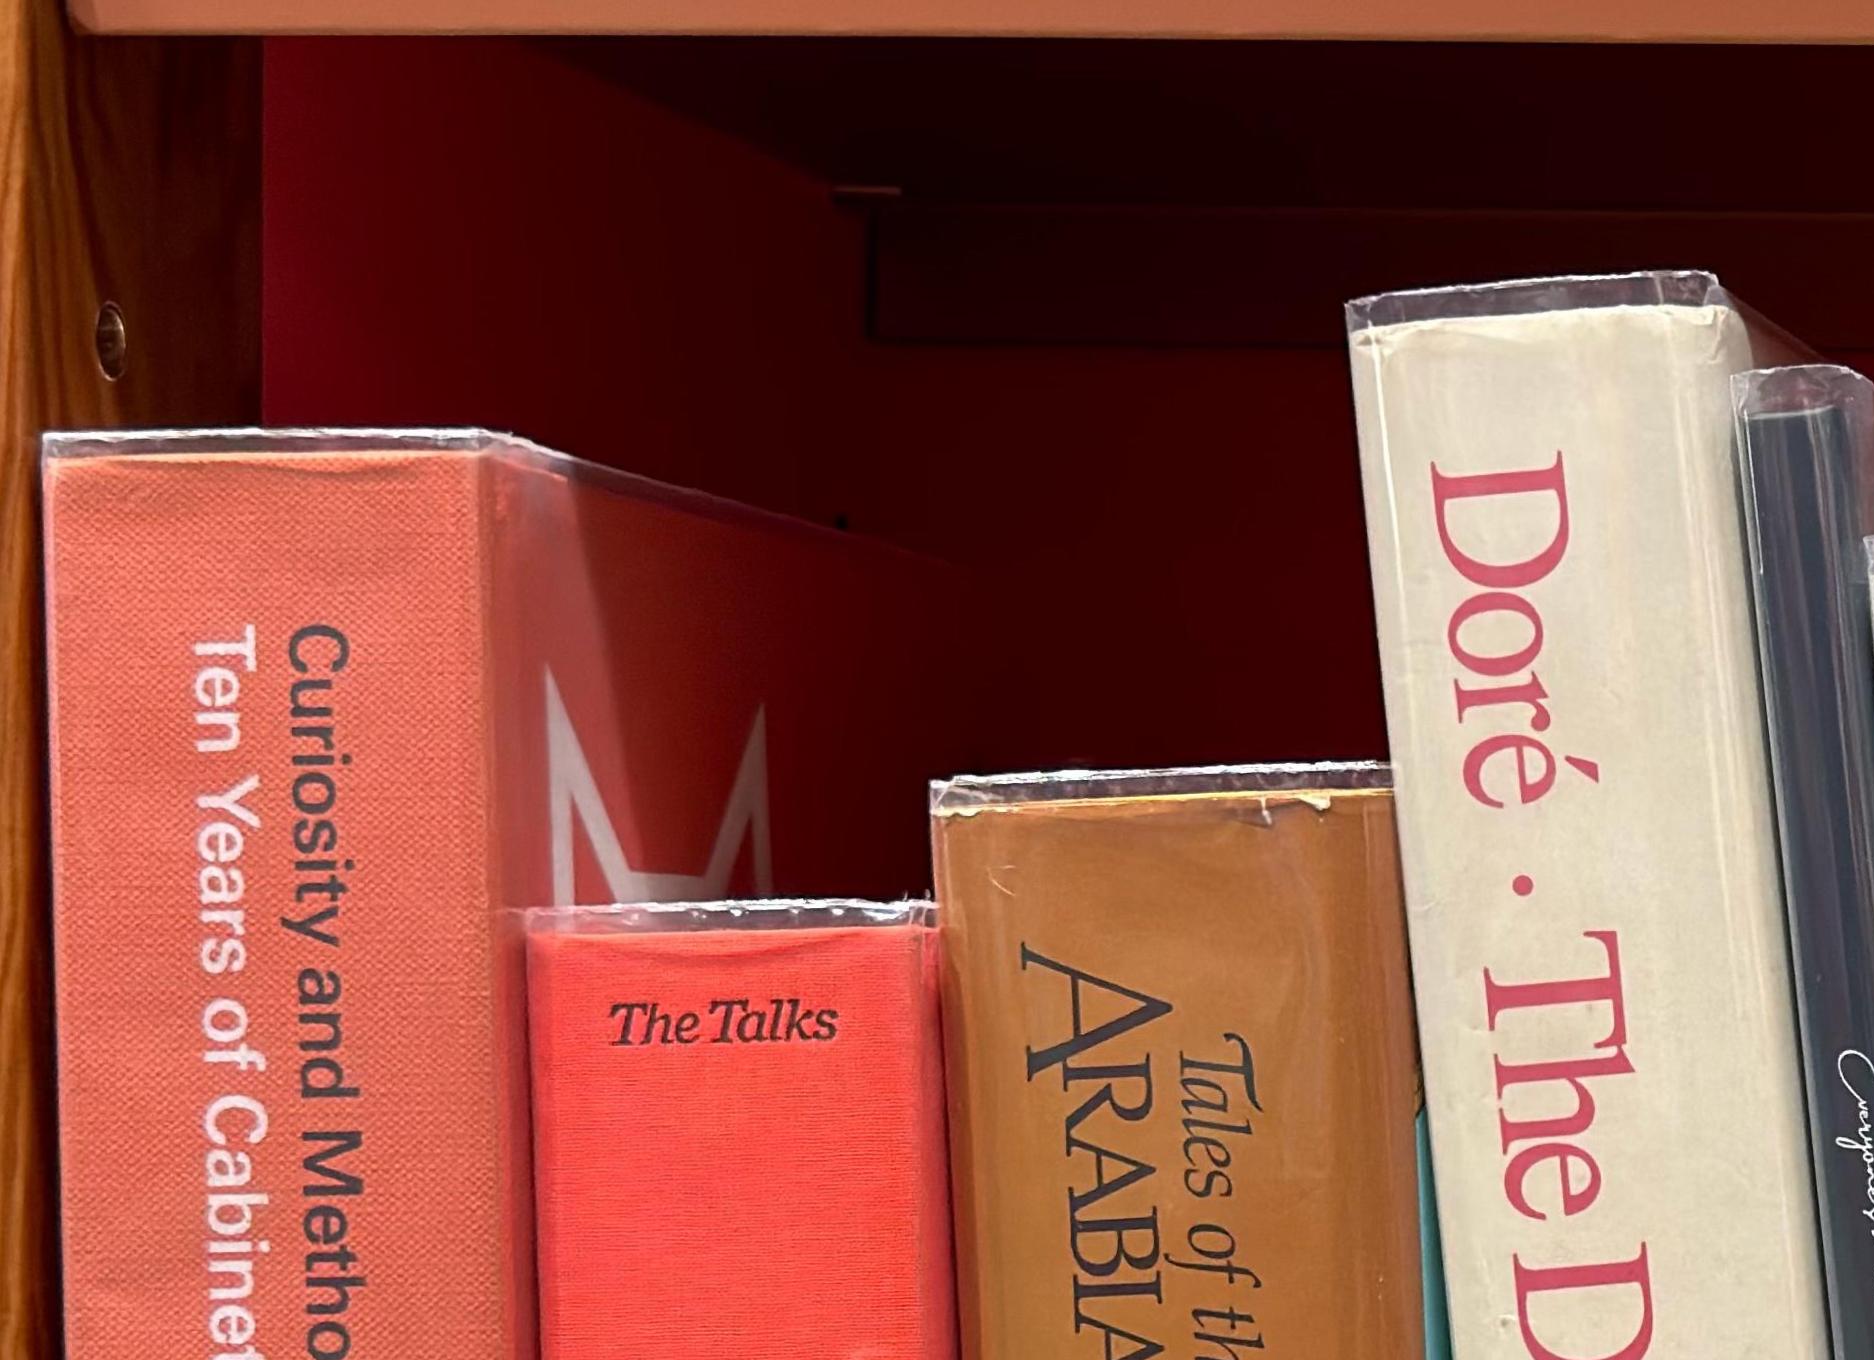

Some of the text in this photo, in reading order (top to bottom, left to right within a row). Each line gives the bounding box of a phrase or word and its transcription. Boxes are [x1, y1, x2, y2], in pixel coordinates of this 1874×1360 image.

[193, 624, 257, 752] Ten
[1430, 450, 1600, 809] Doré
[281, 624, 361, 948] Curiosity
[196, 776, 262, 975] Years
[201, 999, 268, 1073] of
[298, 967, 361, 1100] and
[609, 998, 839, 1047] The Talks
[1483, 930, 1637, 1222] The
[1180, 1032, 1263, 1198] Tales
[1163, 1224, 1262, 1290] of
